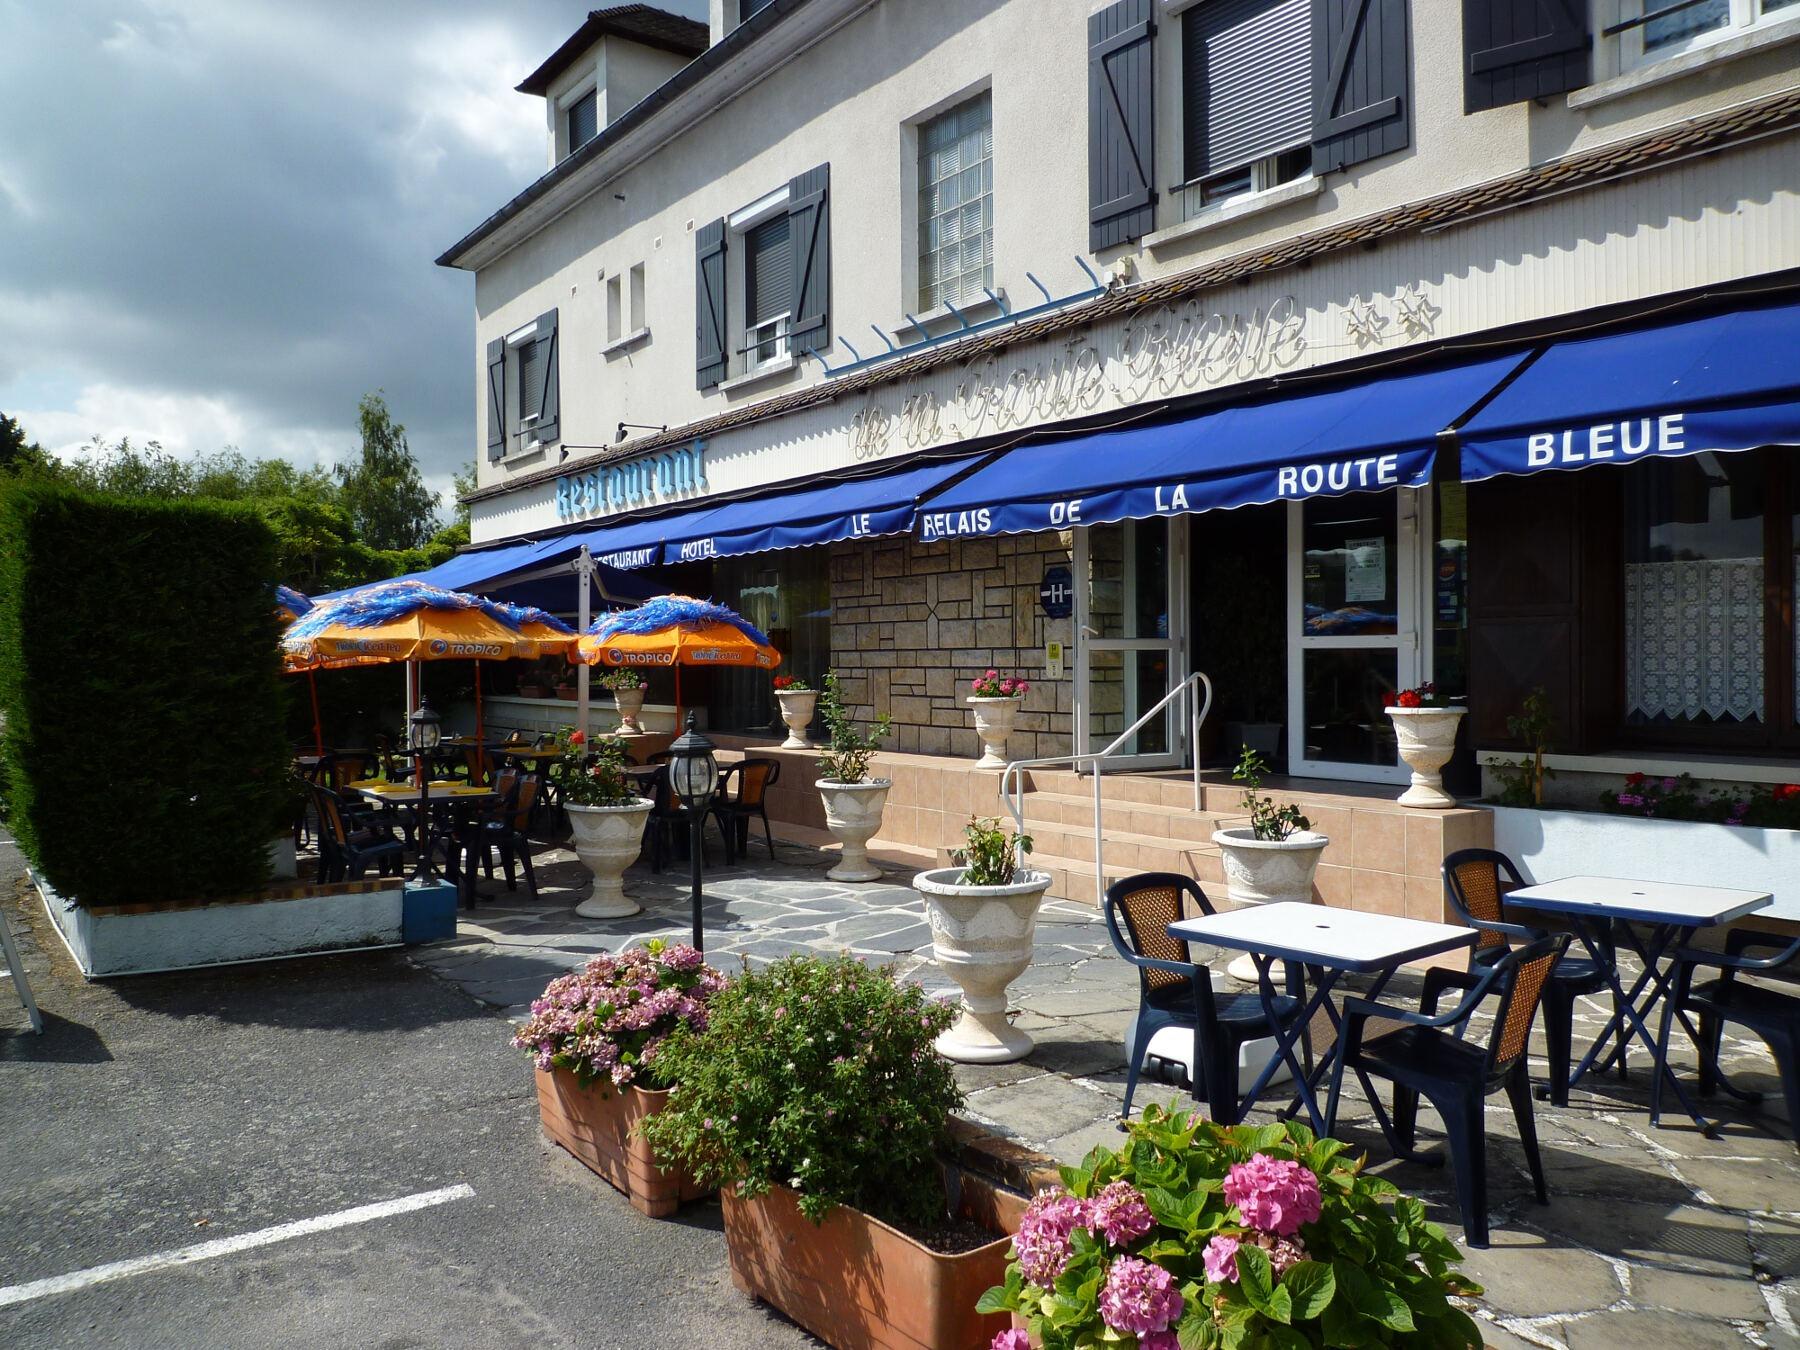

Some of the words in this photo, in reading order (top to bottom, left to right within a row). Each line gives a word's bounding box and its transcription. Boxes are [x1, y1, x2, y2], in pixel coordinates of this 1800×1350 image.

[556, 438, 707, 519] Restaurant
[681, 538, 717, 558] HOTEL
[853, 514, 870, 535] LE
[923, 508, 991, 536] RELAIS
[1050, 499, 1083, 525] DE
[1155, 484, 1190, 512] LA
[1278, 454, 1398, 495] ROUTE
[1527, 413, 1684, 466] BLEUE
[1051, 584, 1063, 604] H
[450, 644, 502, 656] TROPICO
[624, 652, 672, 664] TROPICO
